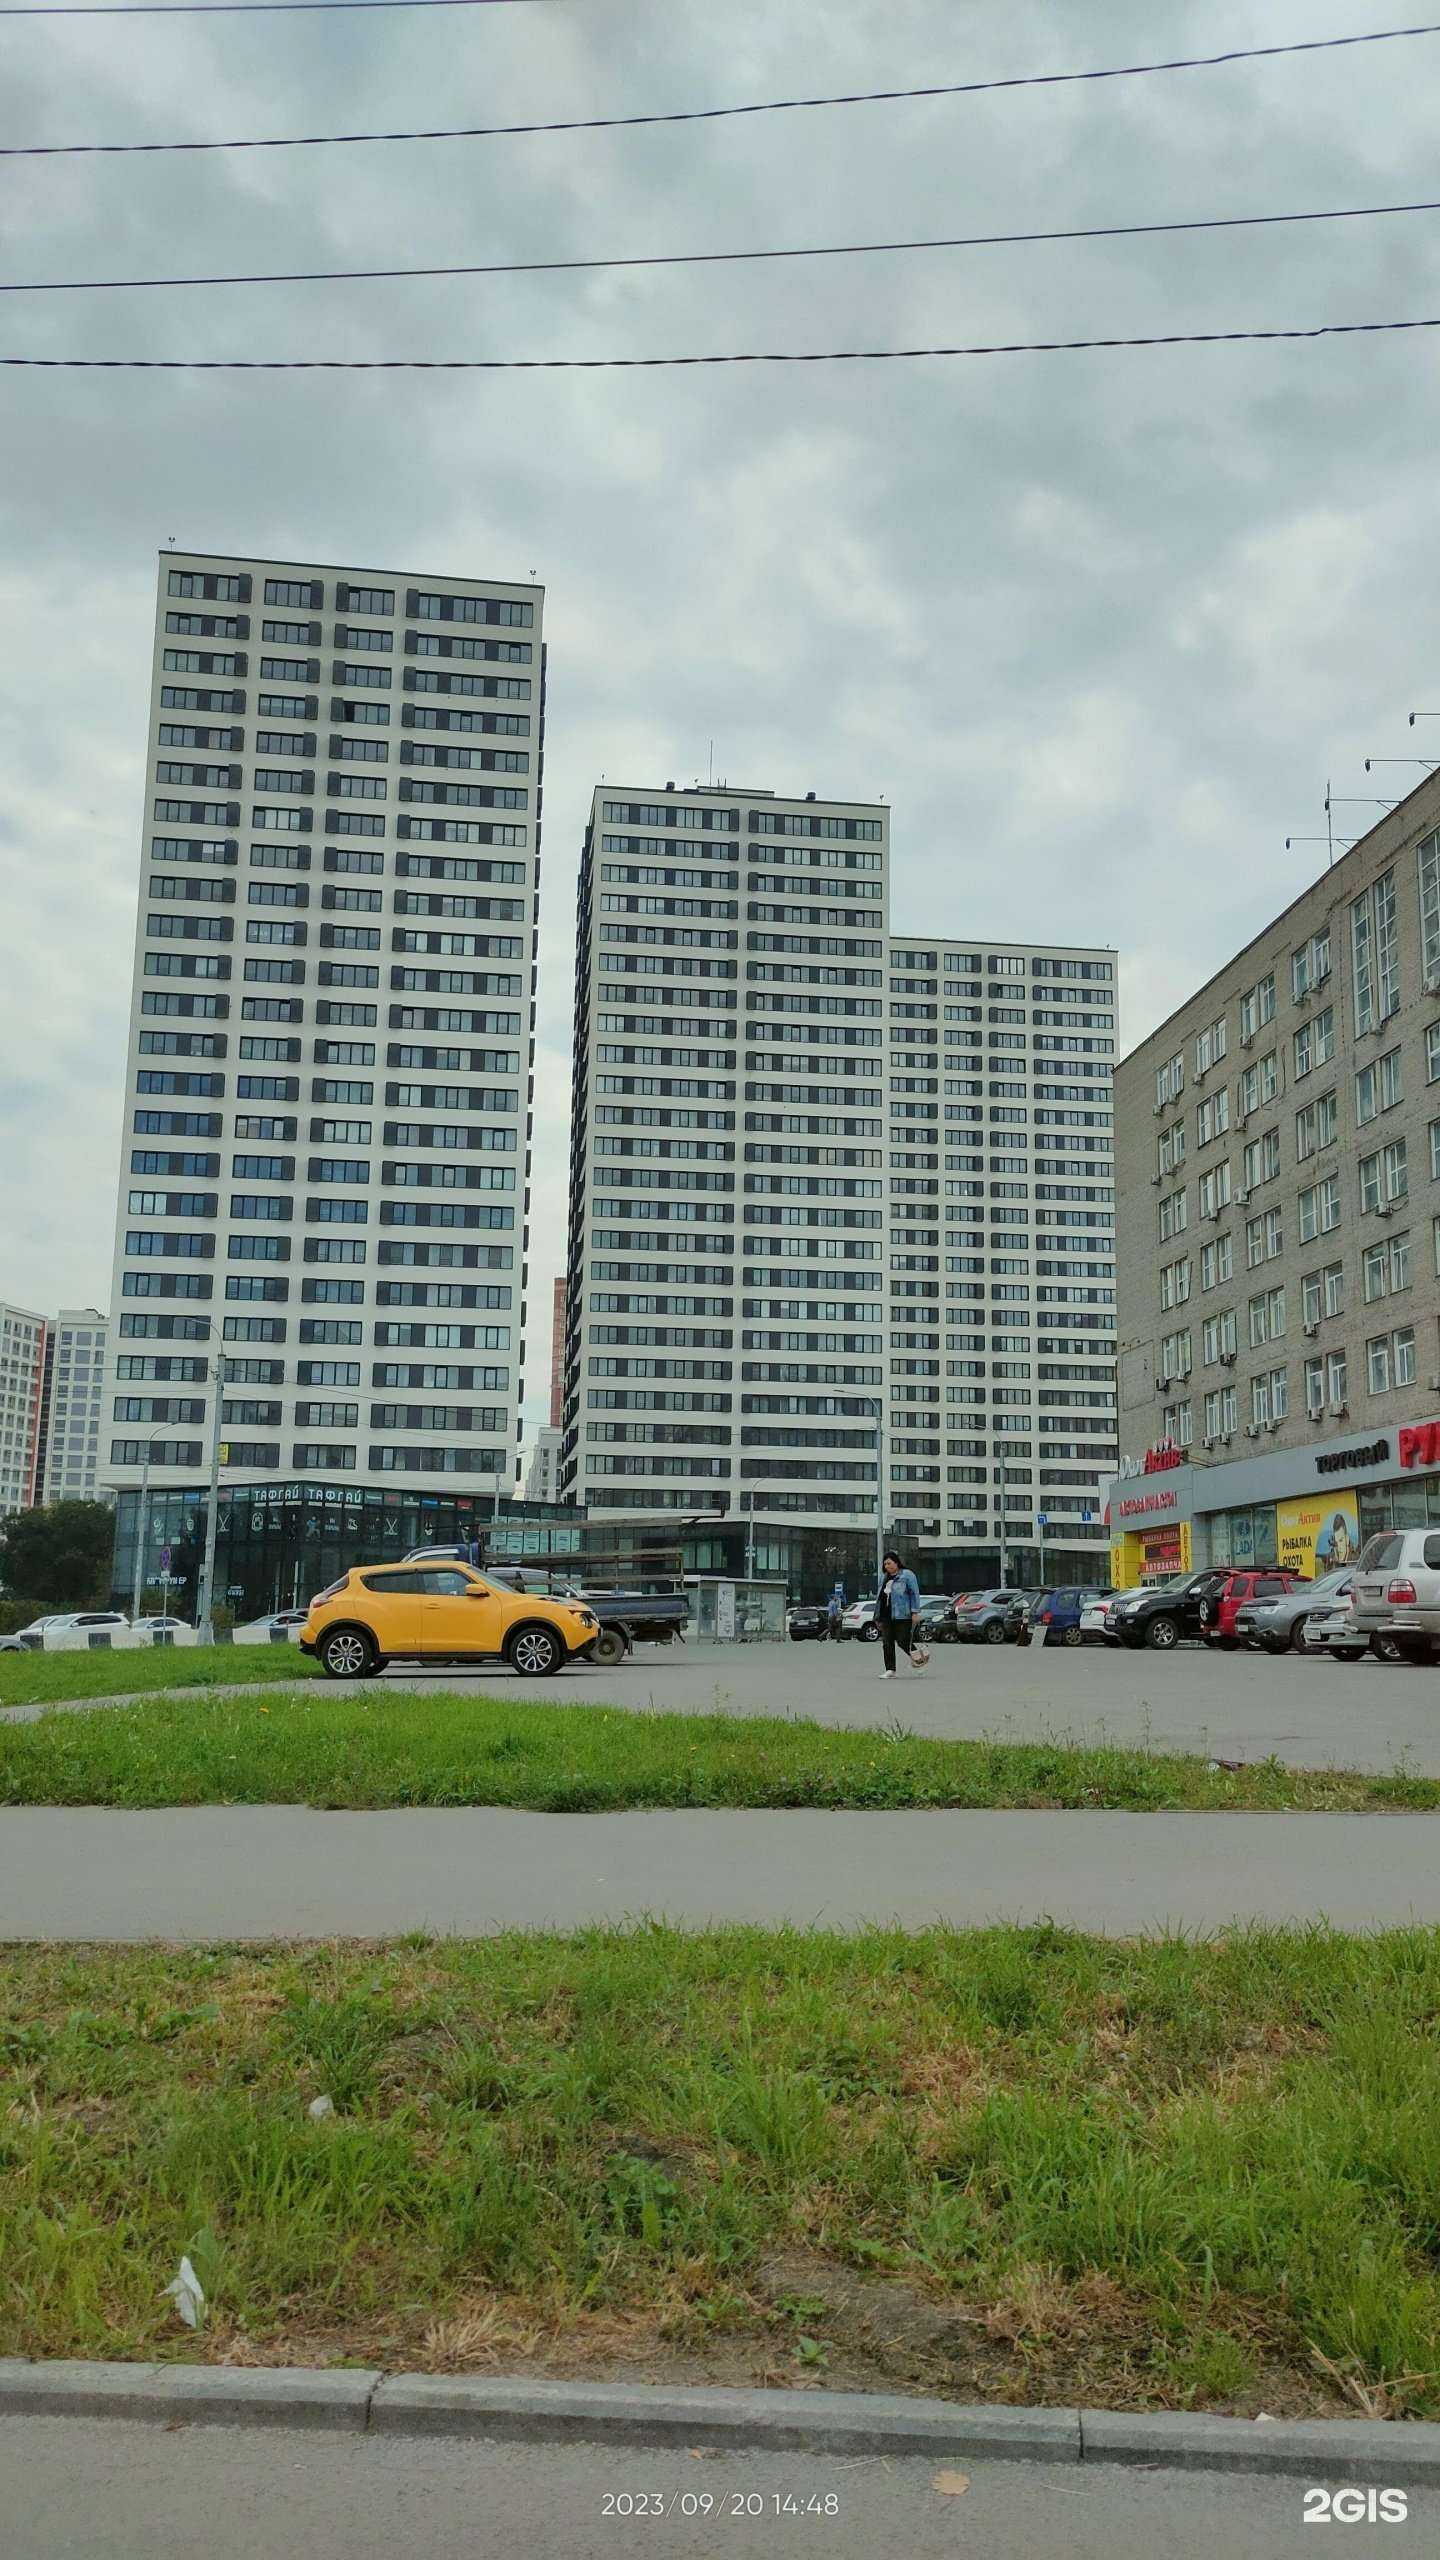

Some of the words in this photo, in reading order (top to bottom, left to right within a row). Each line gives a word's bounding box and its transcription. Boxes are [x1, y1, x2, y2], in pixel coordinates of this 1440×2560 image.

[254, 1484, 299, 1501] ТАФГАЙ
[308, 1488, 362, 1504] ТАФГАЙ
[1282, 1535, 1312, 1550] РЫБАЛКА
[1145, 1557, 1182, 1573] АВТОЗАПЧА
[1282, 1554, 1304, 1567] ОХОТА
